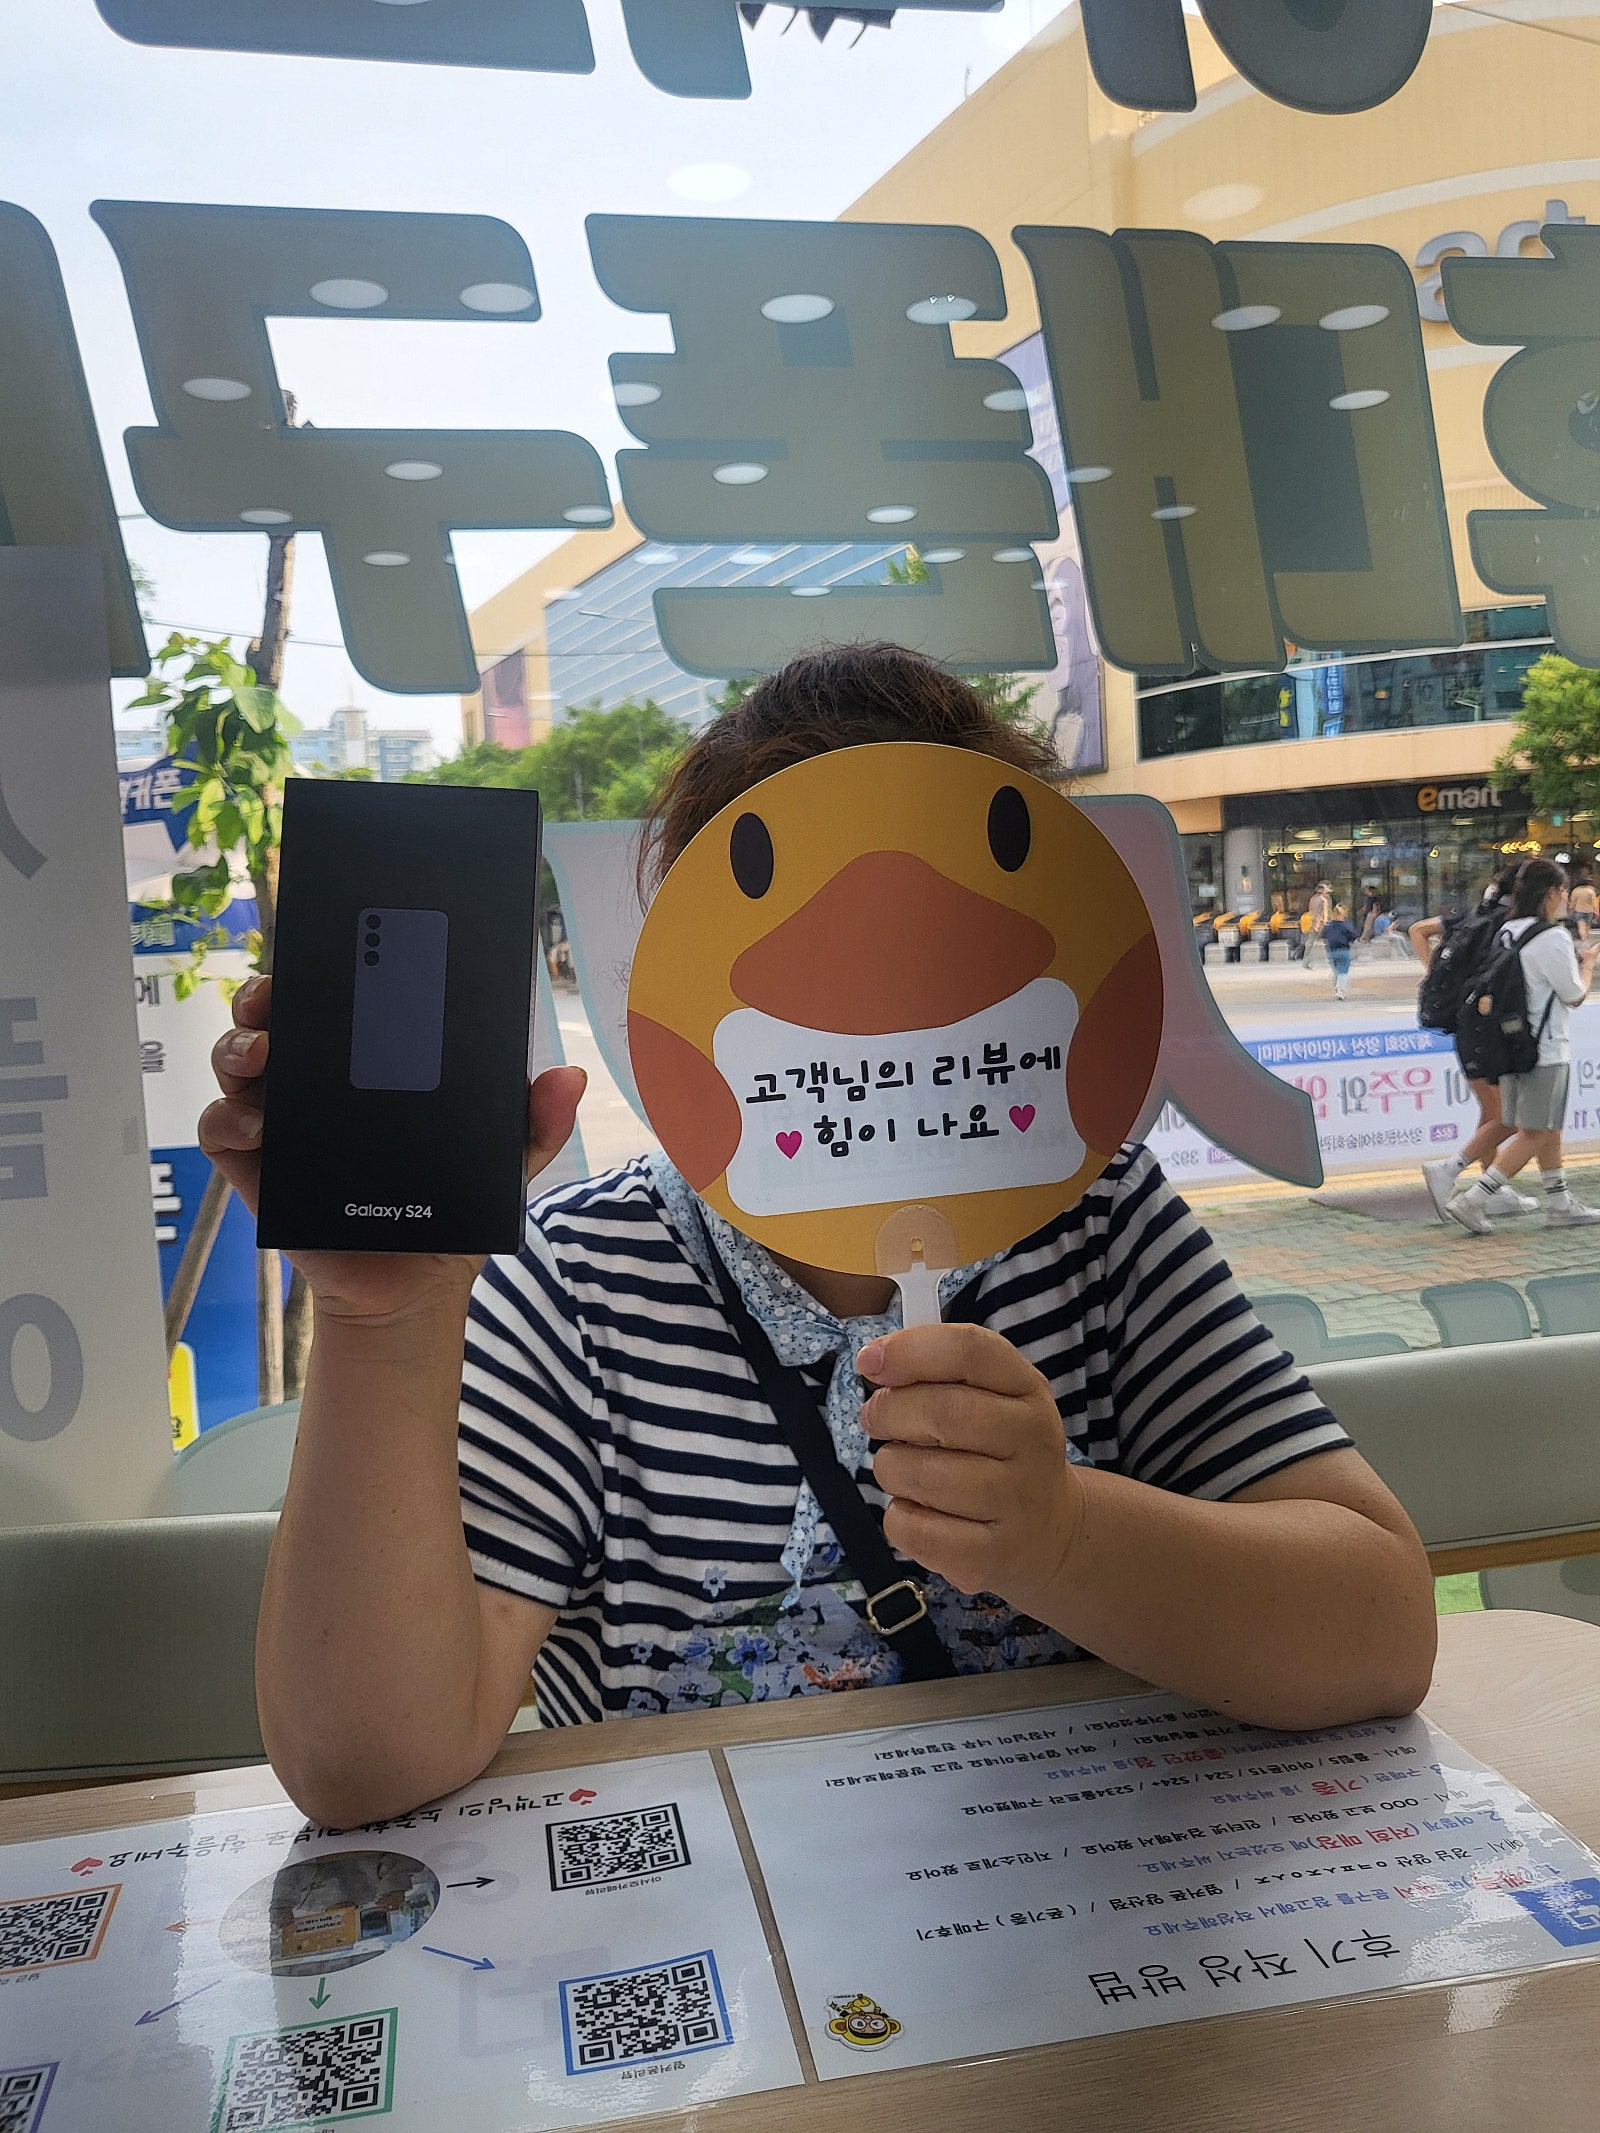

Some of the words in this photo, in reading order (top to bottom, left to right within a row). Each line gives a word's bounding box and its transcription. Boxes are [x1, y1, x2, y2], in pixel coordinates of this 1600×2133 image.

[1417, 784, 1503, 812] emart
[746, 1060, 914, 1103] 고객님의
[933, 1042, 1062, 1086] 리뷰에
[813, 1115, 897, 1158] 힘이
[917, 1104, 1000, 1140] 나요
[344, 1203, 404, 1221] Galaxy
[405, 1204, 433, 1219] S24
[961, 1739, 993, 1750] 너무
[997, 1730, 1056, 1745] 사장님이
[1065, 1744, 1097, 1756] 역시
[1328, 1752, 1370, 1765] 플립5
[1383, 1746, 1417, 1758] 예시
[825, 1766, 926, 1787] 방문해보세요!
[1204, 1770, 1234, 1781] S24
[1248, 1761, 1314, 1776] 아이폰15
[1373, 1768, 1422, 1783] 구매한
[1151, 1776, 1190, 1787] S24+
[1048, 1784, 1134, 1805] S234울트라
[1209, 1790, 1275, 1804] 써주세요
[1433, 1789, 1468, 1803] 예시
[459, 1792, 564, 1816] 고객님의
[961, 1798, 1043, 1816] 구매했어요
[1341, 1804, 1376, 1817] 보고
[1288, 1809, 1339, 1824] 왔어요
[1422, 1811, 1474, 1832] 어떻게
[1477, 1810, 1502, 1823] 2.
[1209, 1819, 1261, 1835] 인터넷
[1365, 1822, 1420, 1843] (저희
[1137, 1827, 1207, 1848] 검색해서
[1485, 1837, 1523, 1854] 예시
[1081, 1839, 1134, 1855] 왔어요
[1216, 1842, 1285, 1861] 오셨는지
[1434, 1847, 1472, 1862] 경남
[964, 1851, 1052, 1871] 지인소개로
[1138, 1855, 1212, 1873] 써주세요.
[1394, 1853, 1432, 1868] 양산
[905, 1864, 959, 1881] 왔어요
[1169, 1883, 1223, 1902] 옆커폰
[1335, 1888, 1390, 1905] 문구를
[1108, 1893, 1164, 1911] 양산점
[1257, 1896, 1332, 1918] 참고해서
[916, 1919, 989, 1941] 구매후기
[1144, 1910, 1255, 1936] 작성해주세요
[1304, 1929, 1400, 1969] 후기
[1199, 1949, 1297, 1987] 작성
[1088, 1964, 1186, 2005] 방법
